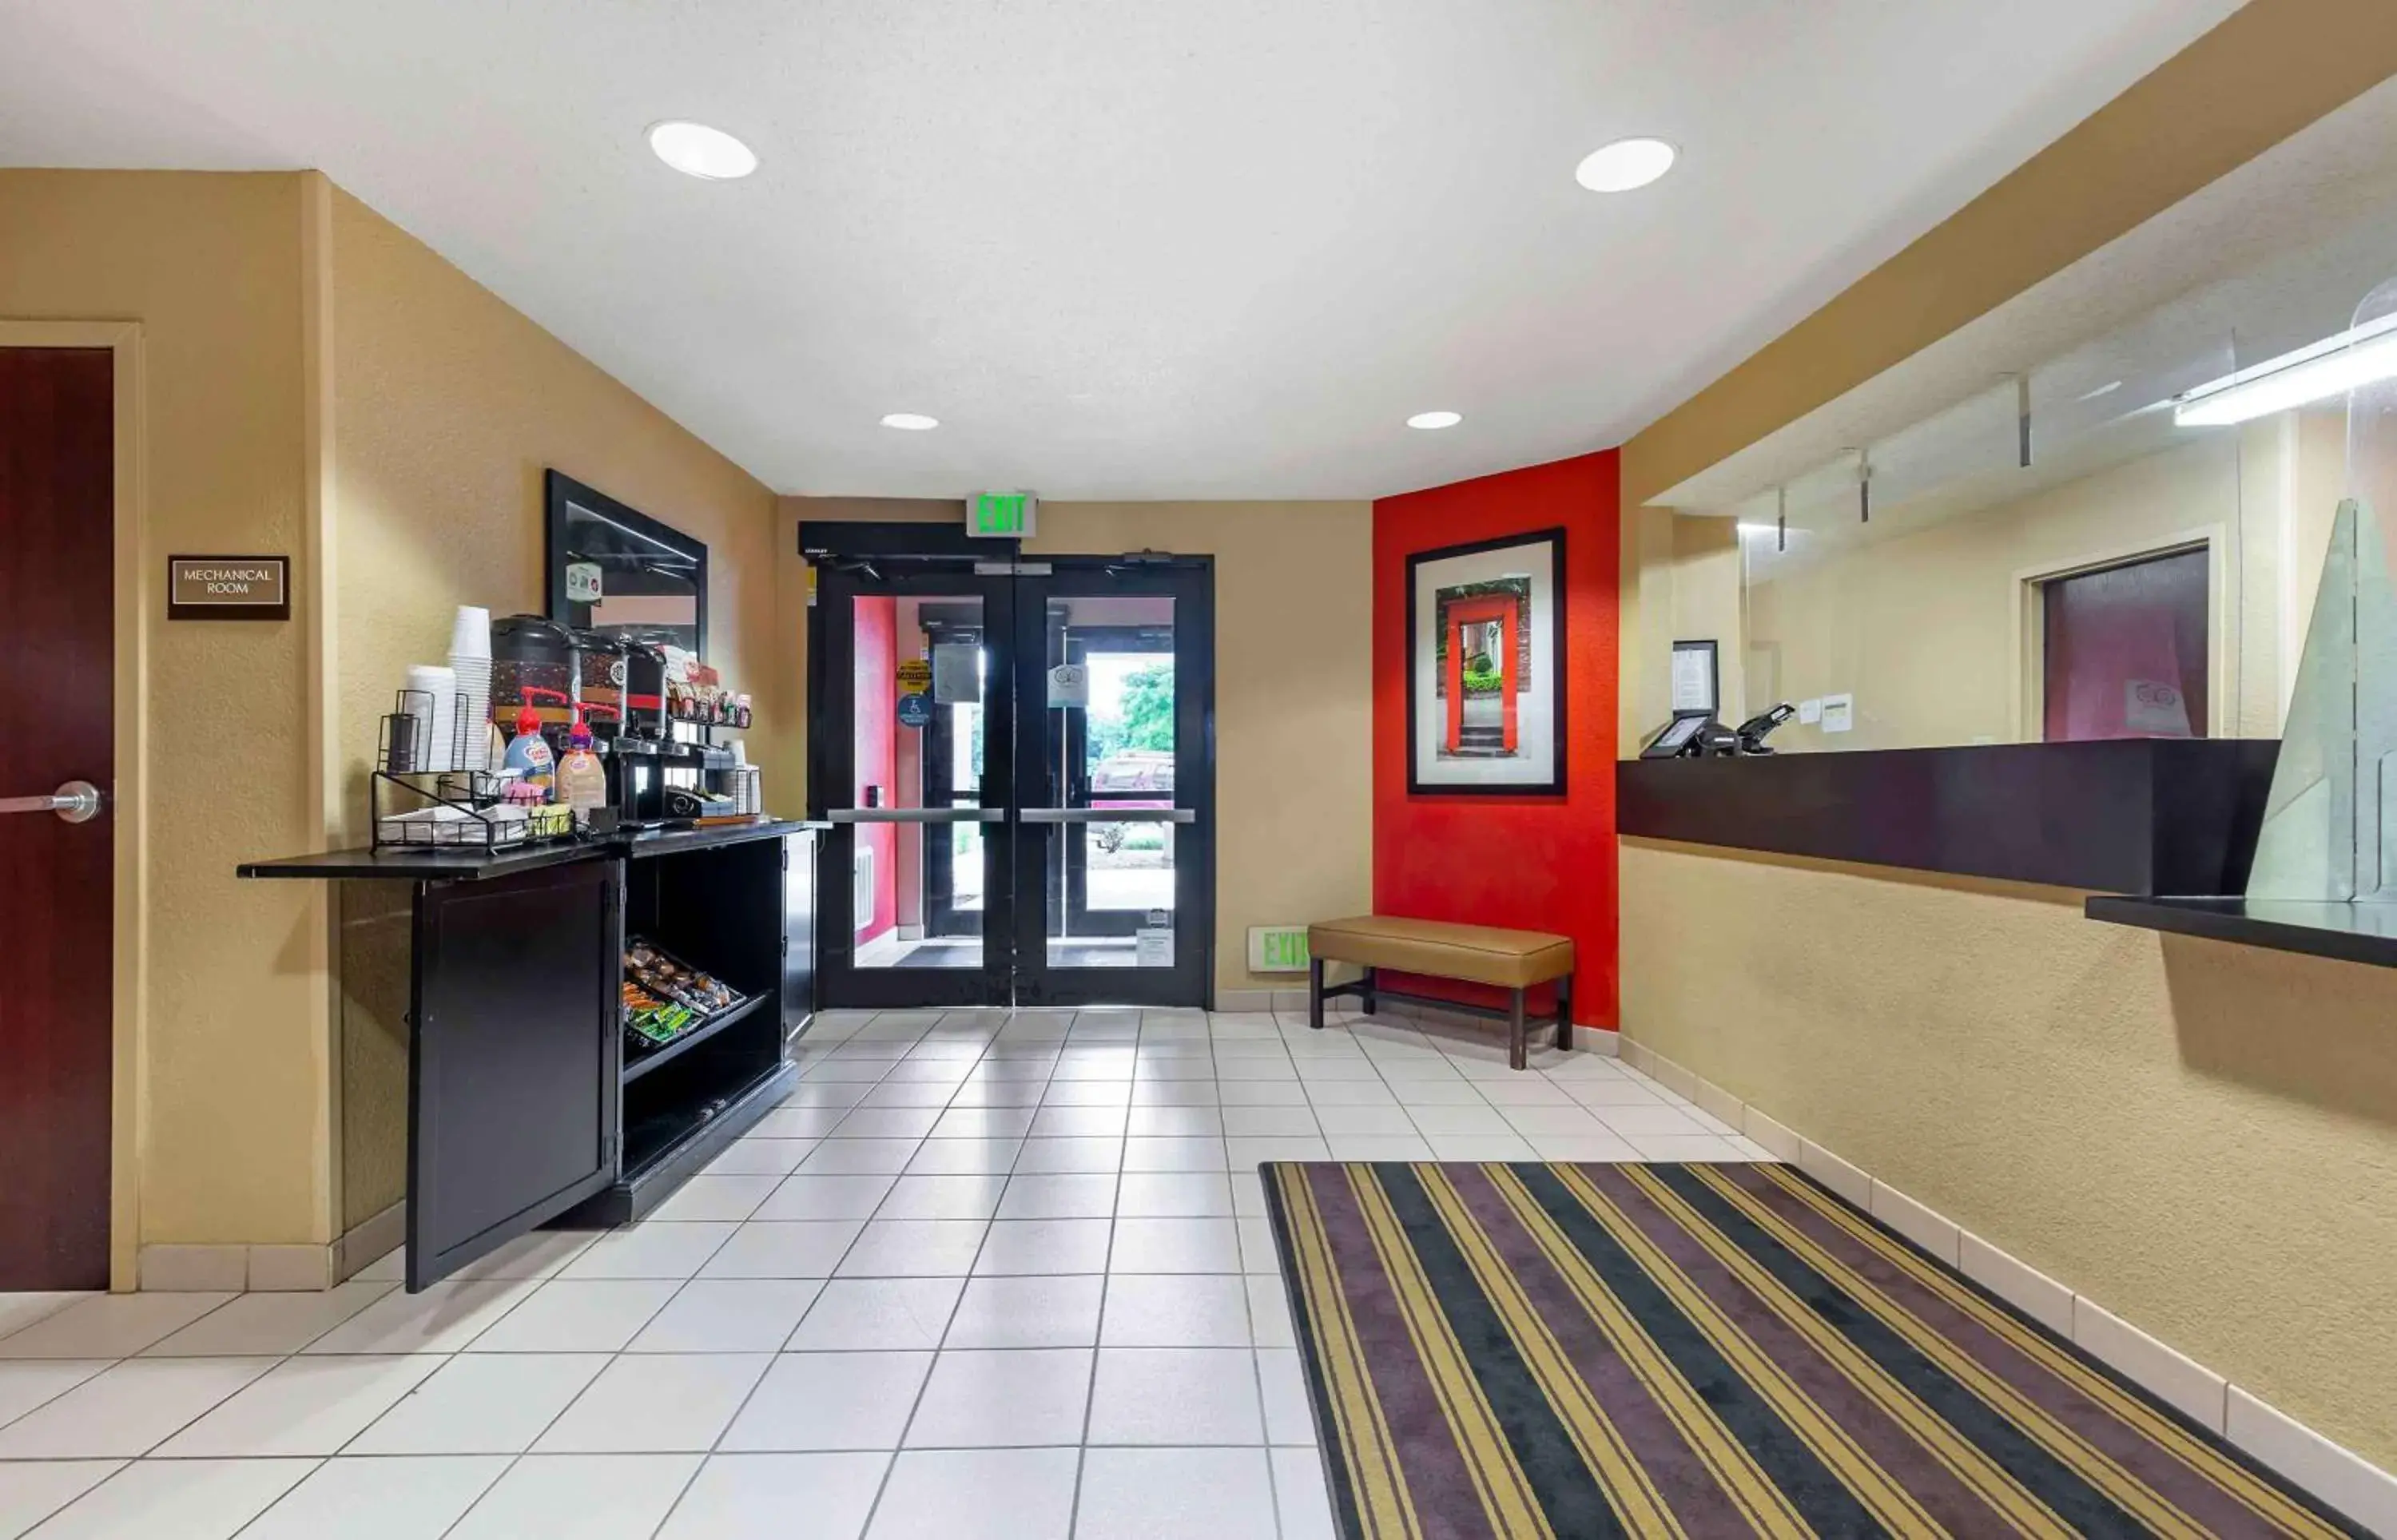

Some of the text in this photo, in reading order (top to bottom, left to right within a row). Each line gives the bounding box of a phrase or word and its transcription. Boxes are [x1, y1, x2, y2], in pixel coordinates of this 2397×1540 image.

[978, 494, 1026, 533] EXIT
[184, 570, 272, 581] MECHANICAL
[207, 582, 248, 593] ROOM
